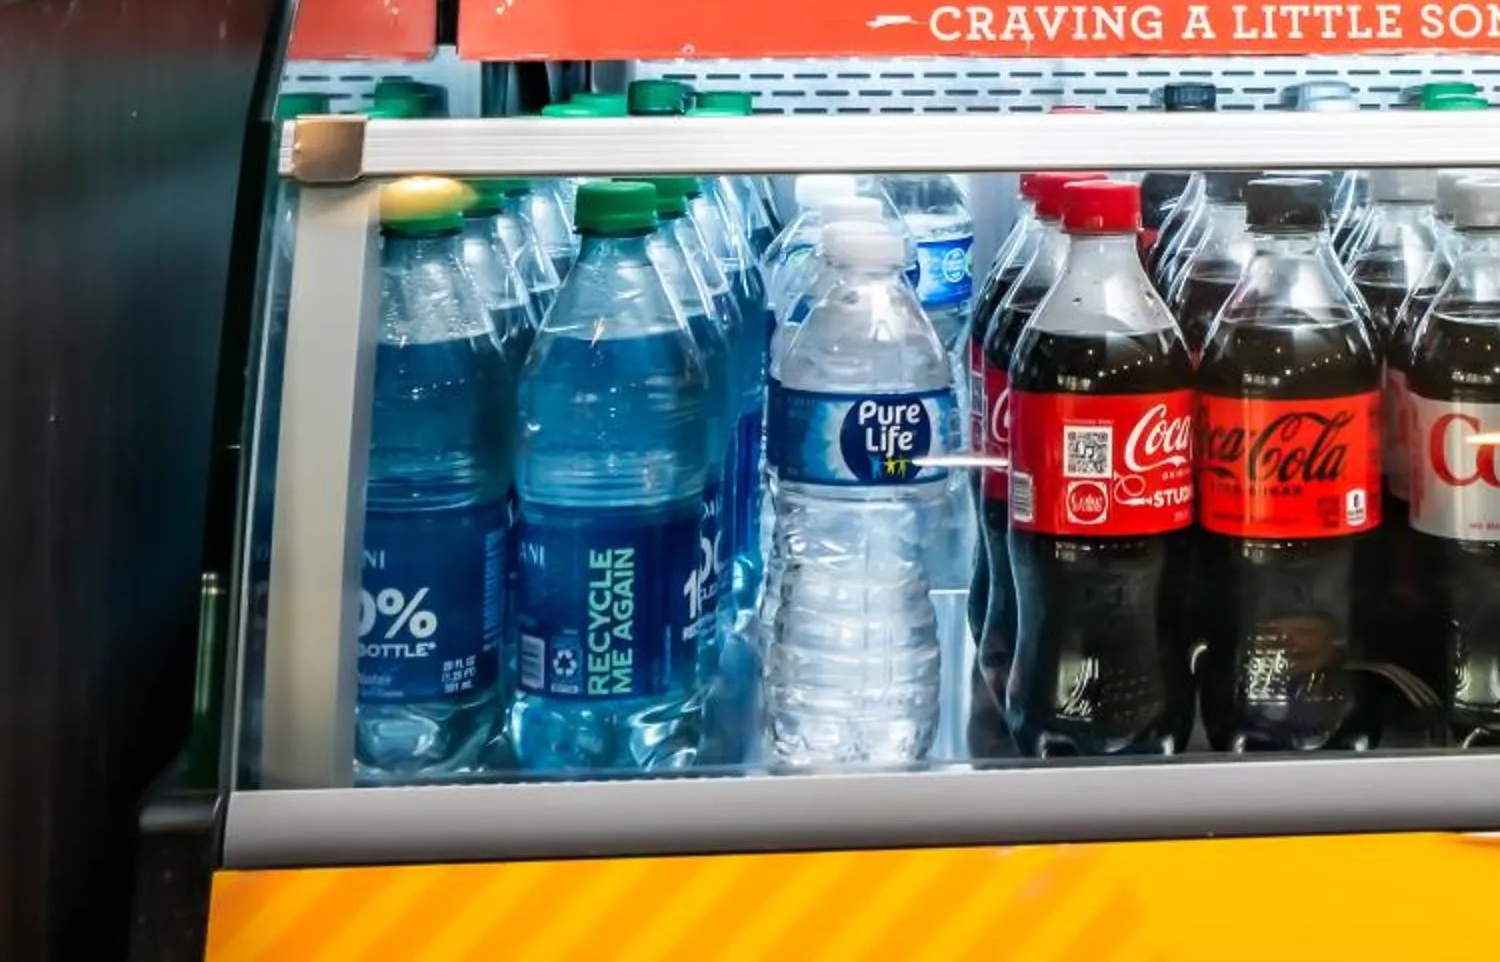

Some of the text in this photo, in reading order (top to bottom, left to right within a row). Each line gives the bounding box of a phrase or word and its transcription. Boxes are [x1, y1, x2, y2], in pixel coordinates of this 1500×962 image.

[929, 5, 1163, 41] CRAVING
[1182, 5, 1226, 40] A
[1232, 4, 1403, 40] LITTLE
[858, 400, 921, 425] Pure
[865, 426, 913, 457] Life
[588, 549, 613, 695] RECYCLE
[612, 548, 635, 694] ME AGAIN
